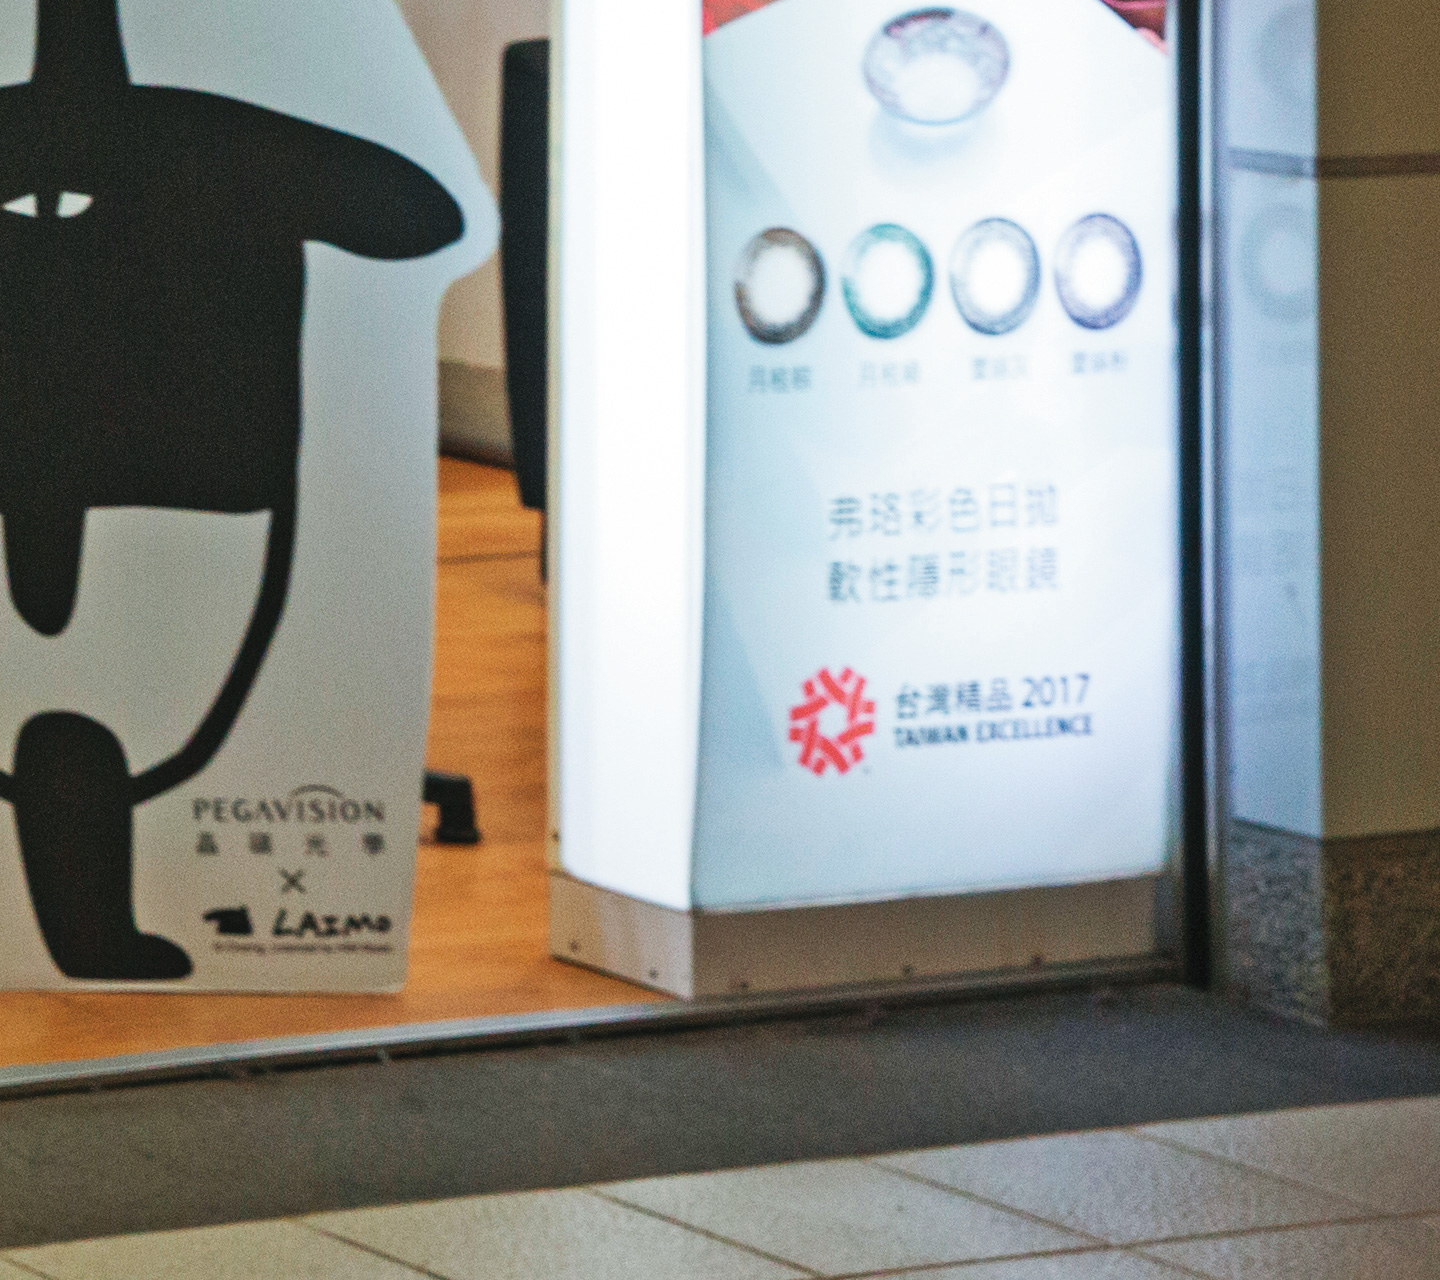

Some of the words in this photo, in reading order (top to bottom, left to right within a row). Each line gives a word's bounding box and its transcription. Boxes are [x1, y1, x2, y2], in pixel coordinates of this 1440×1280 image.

[896, 680, 1014, 720] 台灣精品
[1021, 671, 1092, 709] 2017
[894, 724, 971, 748] TAIWAN
[976, 711, 1094, 744] EXCELLENCE
[192, 797, 385, 823] PEGAVISION
